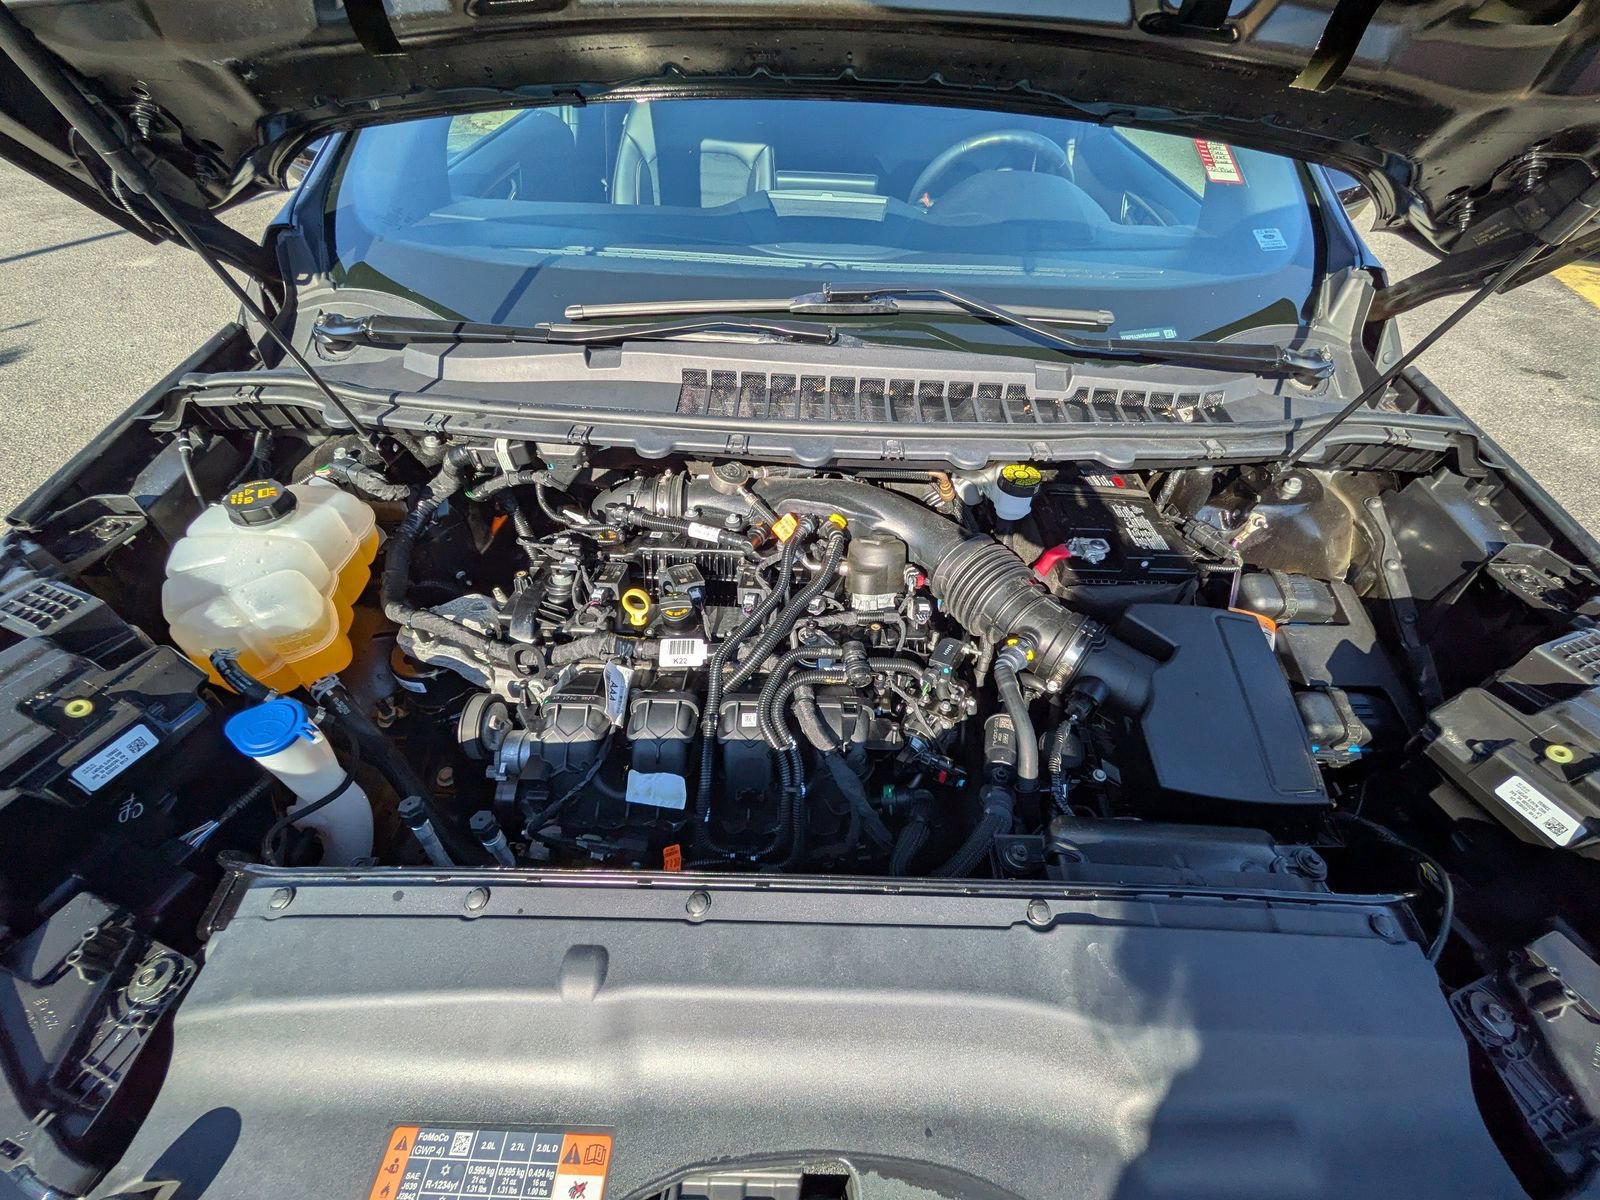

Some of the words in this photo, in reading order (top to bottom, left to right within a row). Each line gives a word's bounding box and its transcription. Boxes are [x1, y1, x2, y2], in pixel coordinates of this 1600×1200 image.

[673, 657, 688, 665] K22
[418, 1132, 450, 1142] FoMoCo
[481, 1141, 496, 1150] 2.0L
[510, 1142, 525, 1152] 2.7L
[536, 1144, 551, 1153] 2.0L
[551, 1145, 559, 1153] D
[411, 1144, 436, 1156] (GWP
[436, 1146, 446, 1158] 4)
[405, 1172, 421, 1180] SAE
[468, 1166, 486, 1175] 0.595
[486, 1168, 496, 1178] kg
[498, 1167, 516, 1177] 0.595
[516, 1169, 525, 1179] kg
[528, 1168, 546, 1177] 0.454
[545, 1170, 555, 1180] kg
[471, 1176, 479, 1184] 21
[501, 1177, 510, 1185] 21
[532, 1179, 540, 1187] 16
[401, 1182, 418, 1191] J639
[466, 1184, 479, 1193] 1.31
[497, 1186, 509, 1194] 1.31
[527, 1187, 539, 1196] 1.00
